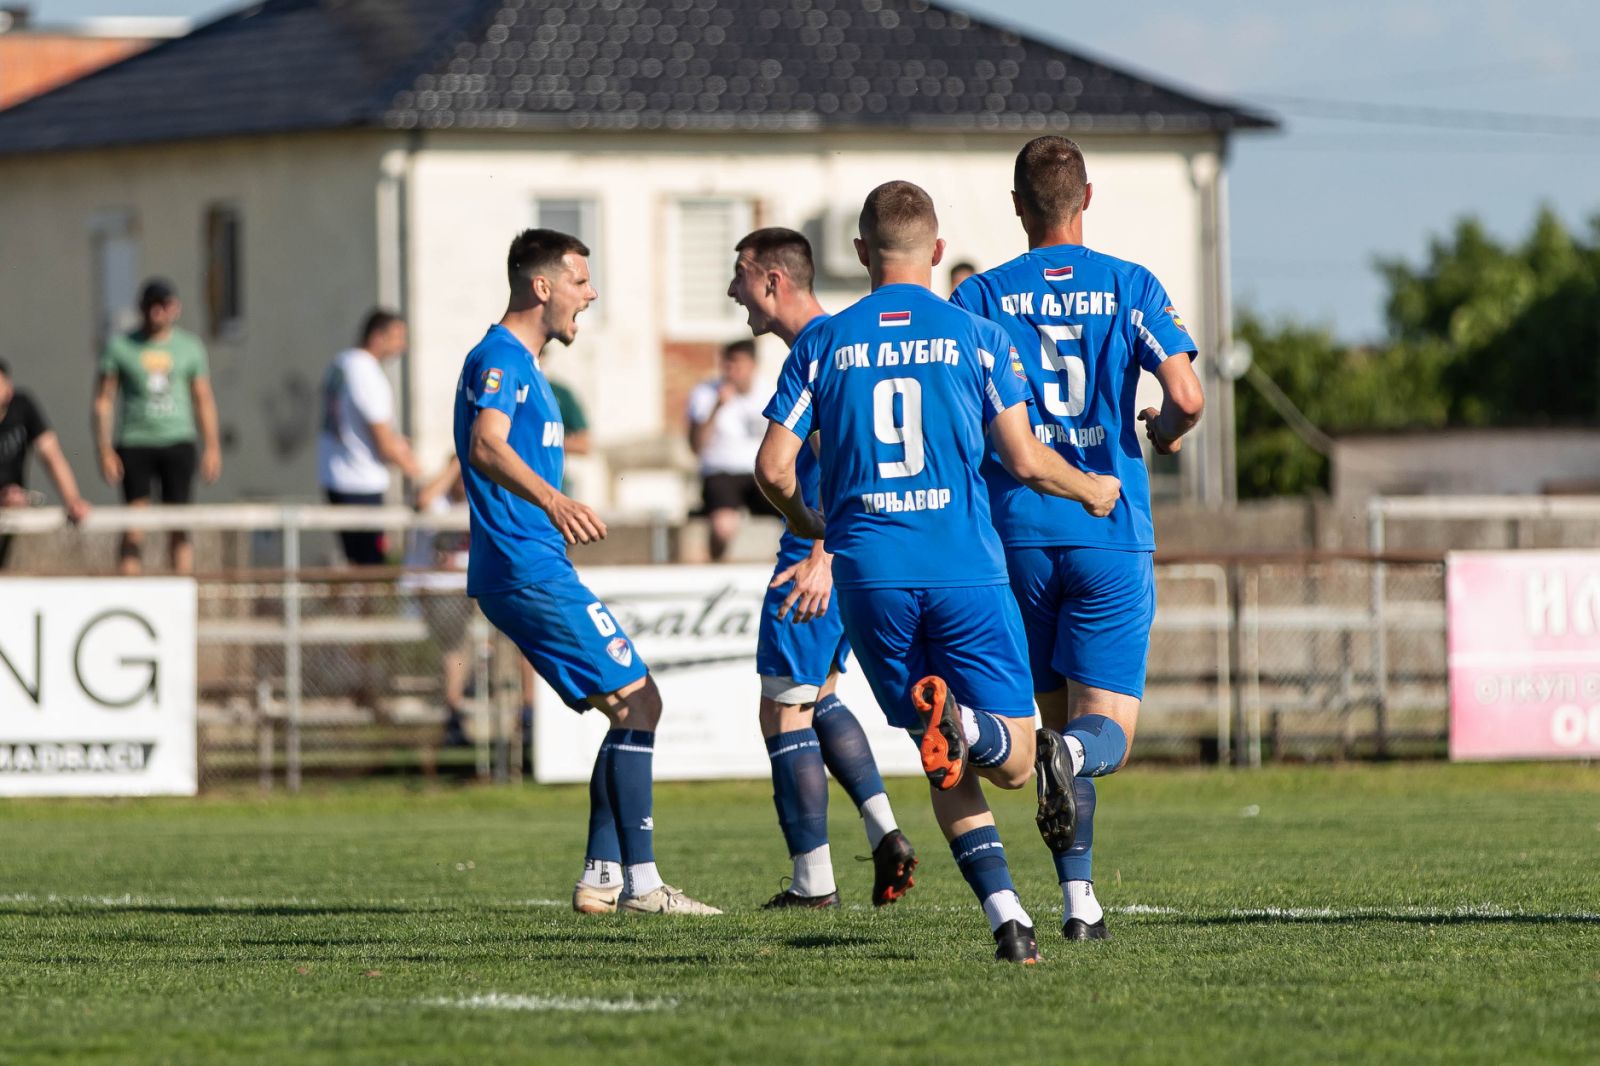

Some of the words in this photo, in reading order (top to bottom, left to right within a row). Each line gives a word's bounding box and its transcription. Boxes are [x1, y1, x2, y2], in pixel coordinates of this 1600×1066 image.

[1001, 292, 1035, 316] ФК
[1040, 291, 1118, 316] ЉУБИЋ
[835, 343, 870, 370] ФК
[877, 338, 960, 367] ЉУБИЋ
[1037, 324, 1087, 417] 5
[873, 377, 925, 479] 9
[862, 488, 951, 513] ПРЊАВОР
[587, 602, 617, 637] 6
